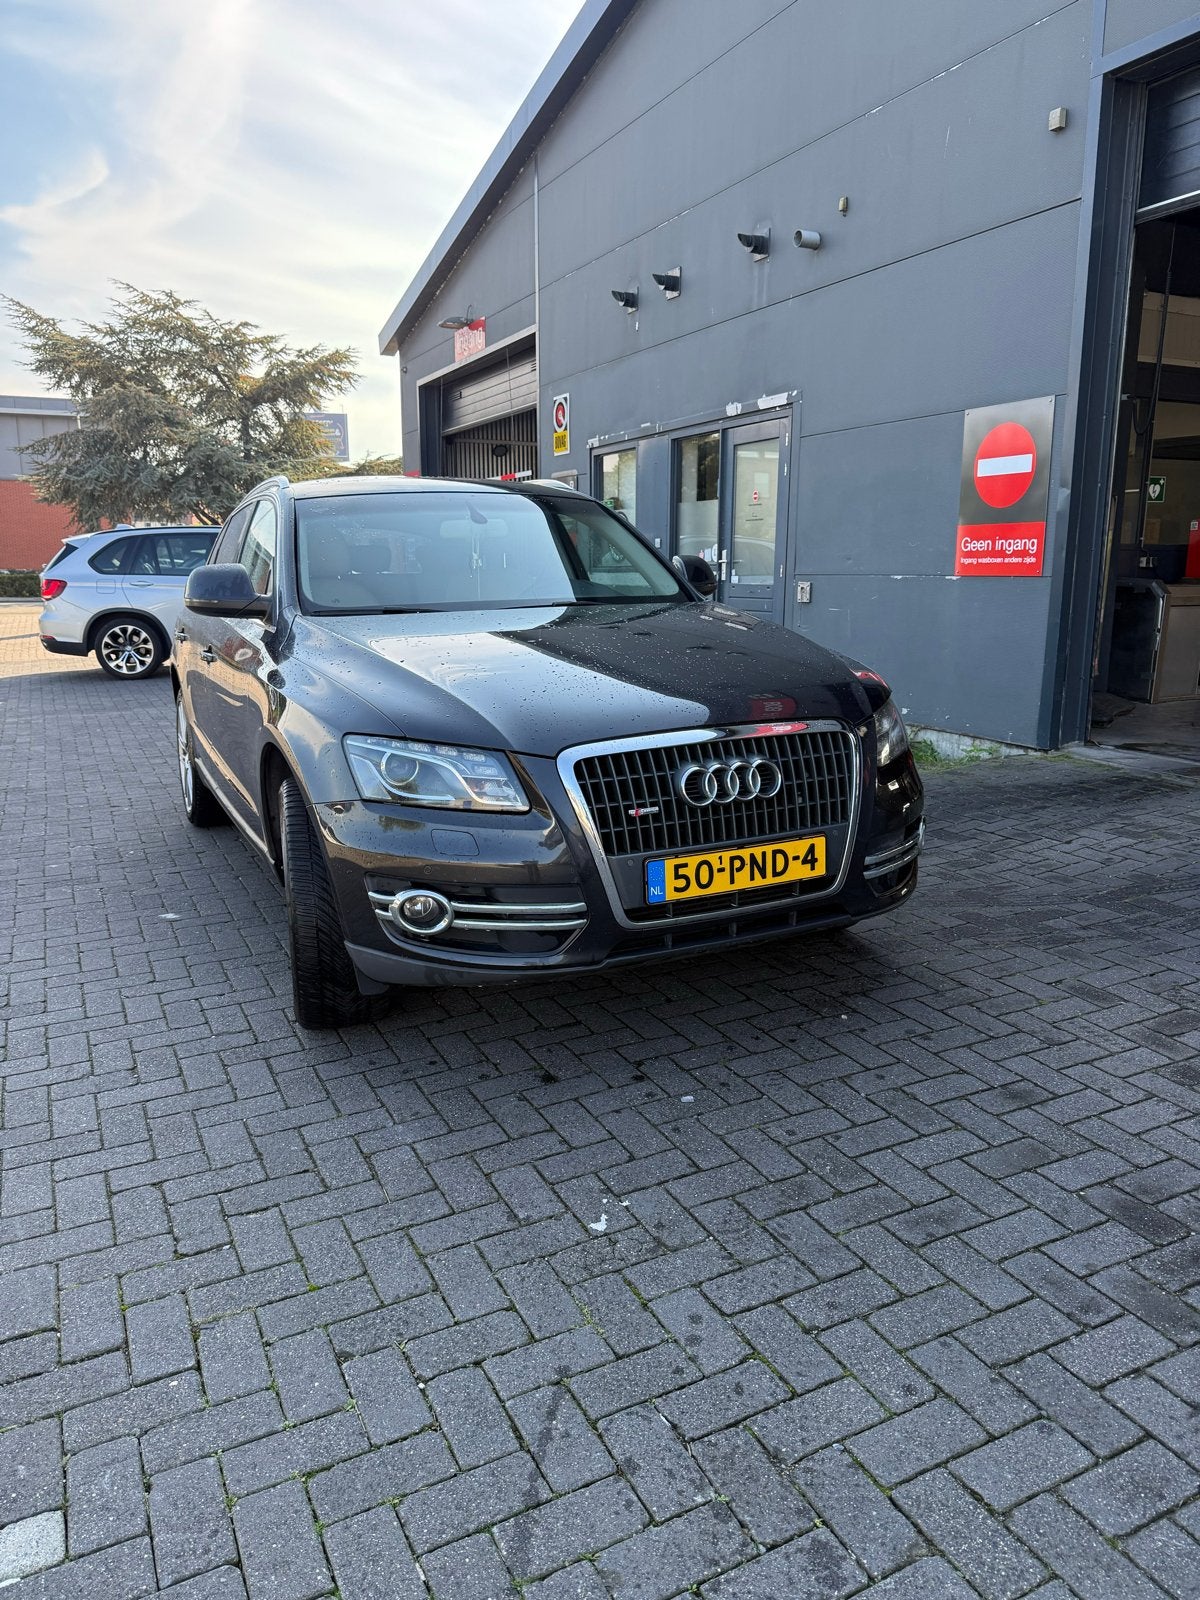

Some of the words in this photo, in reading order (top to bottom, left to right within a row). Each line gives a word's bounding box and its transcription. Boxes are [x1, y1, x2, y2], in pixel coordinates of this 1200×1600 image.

[961, 537, 992, 551] Geen
[995, 536, 1038, 554] ingang
[1023, 556, 1036, 564] zijde
[673, 843, 818, 893] 50-PND-4
[650, 886, 663, 896] NL
